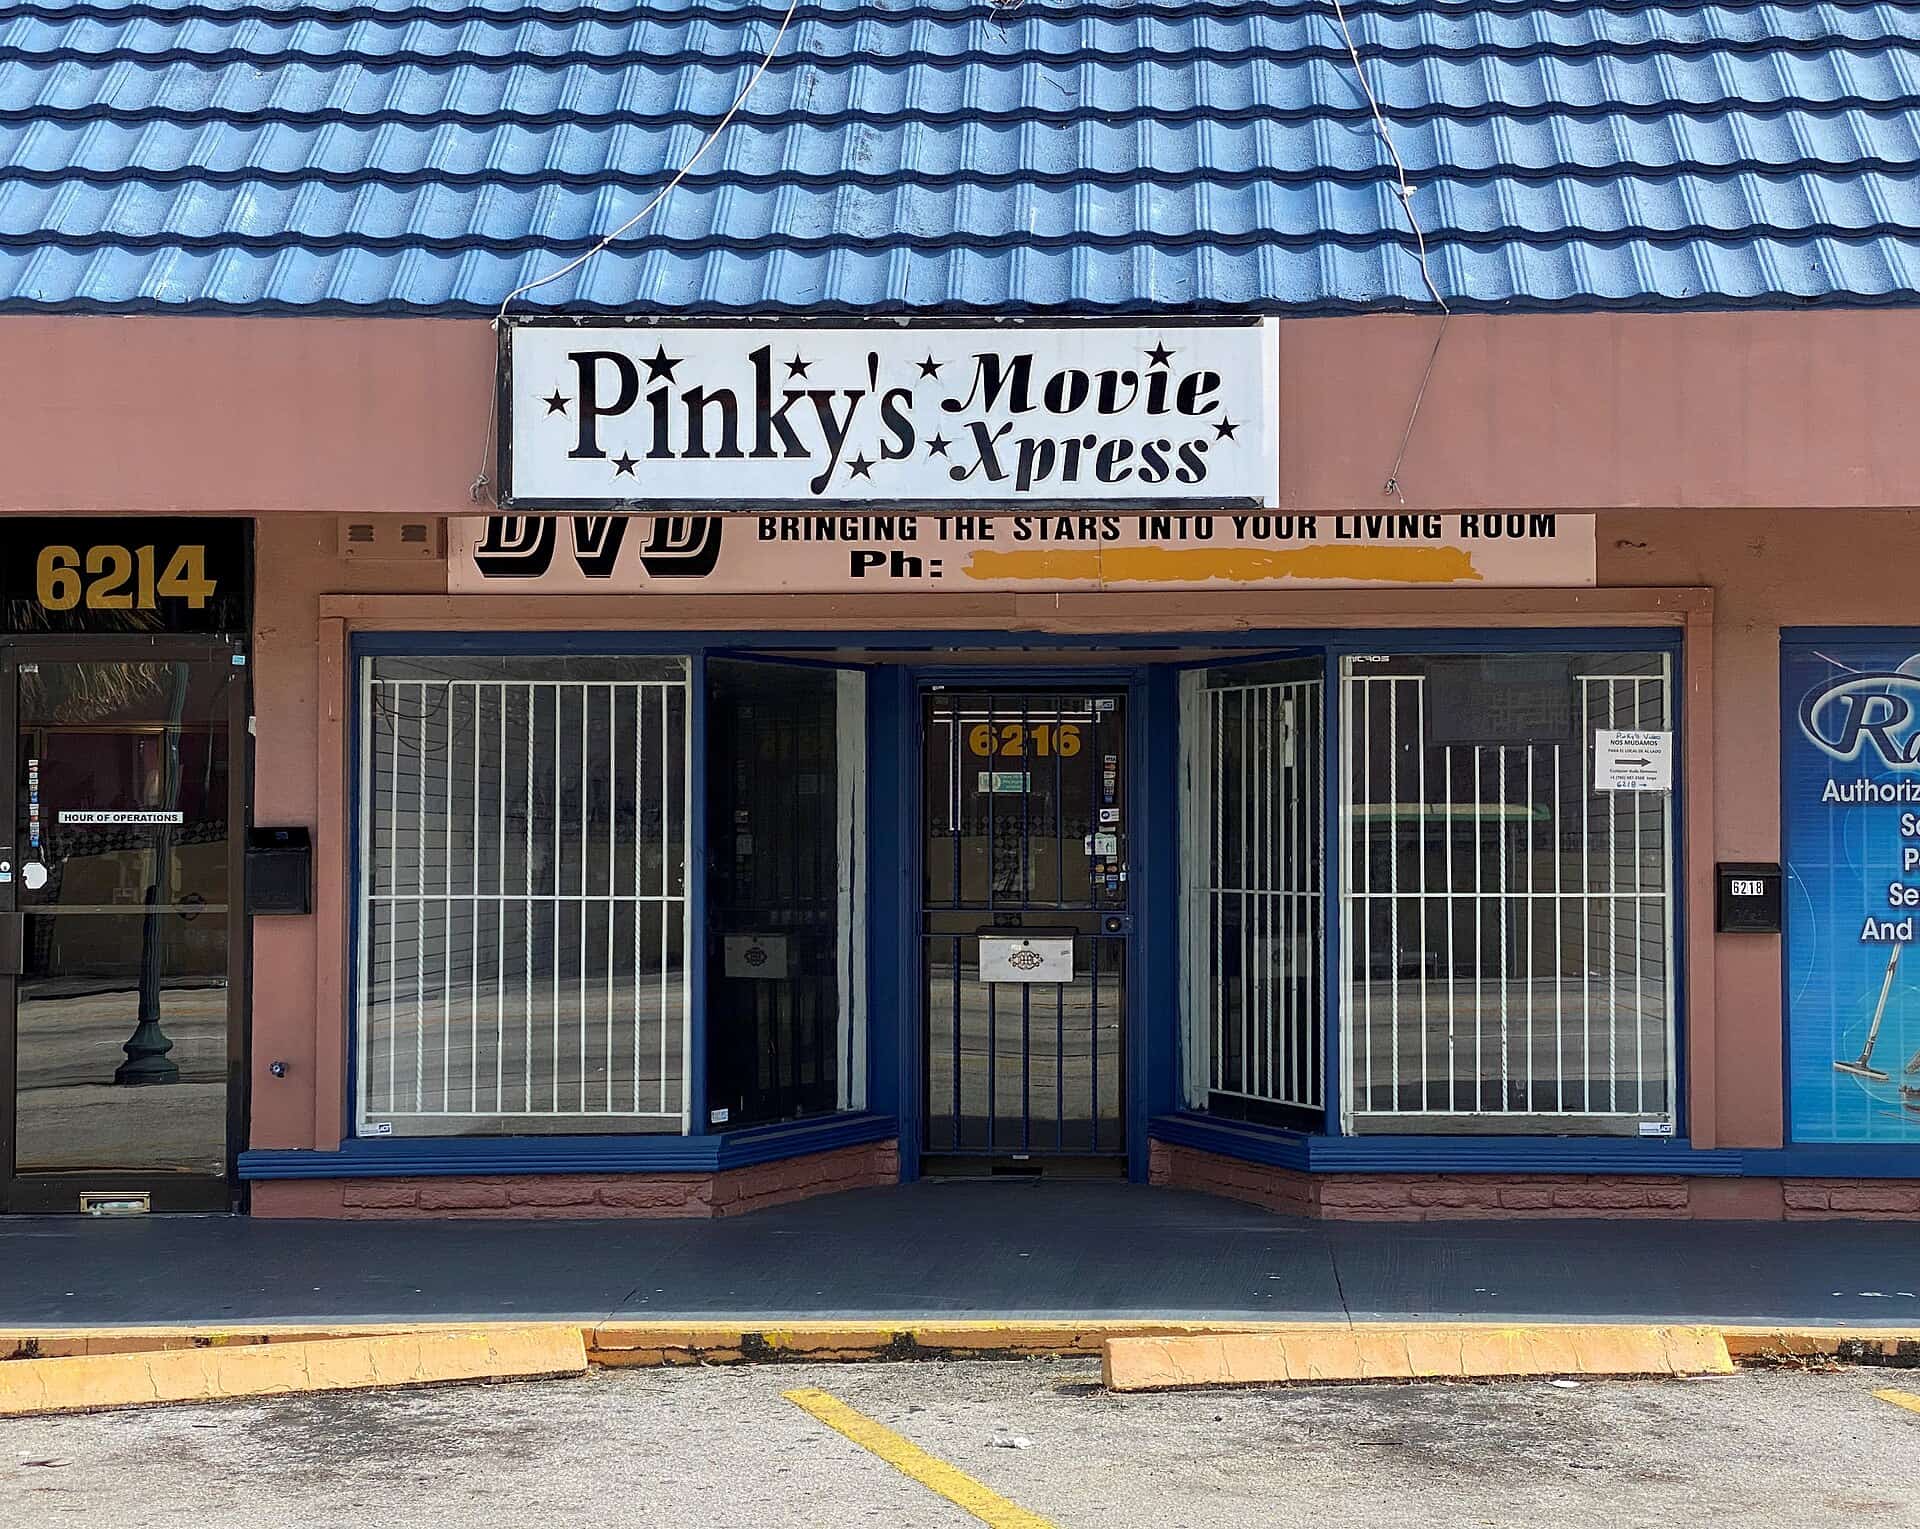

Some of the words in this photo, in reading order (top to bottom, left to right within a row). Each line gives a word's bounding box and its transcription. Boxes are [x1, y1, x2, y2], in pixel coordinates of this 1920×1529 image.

[941, 341, 1221, 416] Movie
[567, 344, 916, 495] Pinky's
[949, 420, 1210, 492] Xpress
[757, 516, 918, 541] BRINGING
[934, 516, 996, 541] THE
[1012, 515, 1121, 541] STARS
[1138, 515, 1214, 540] INTO
[1231, 515, 1318, 539] YOUR
[1334, 515, 1443, 539] LIVING
[1459, 514, 1557, 538] ROOM
[36, 545, 217, 610] 6214
[849, 550, 944, 578] Ph:
[968, 724, 1081, 757] 6216
[64, 813, 95, 823] HOUR
[97, 813, 112, 823] OF
[113, 813, 178, 823] OPERATIONS
[1732, 880, 1763, 895] 6218
[1861, 917, 1913, 941] And
